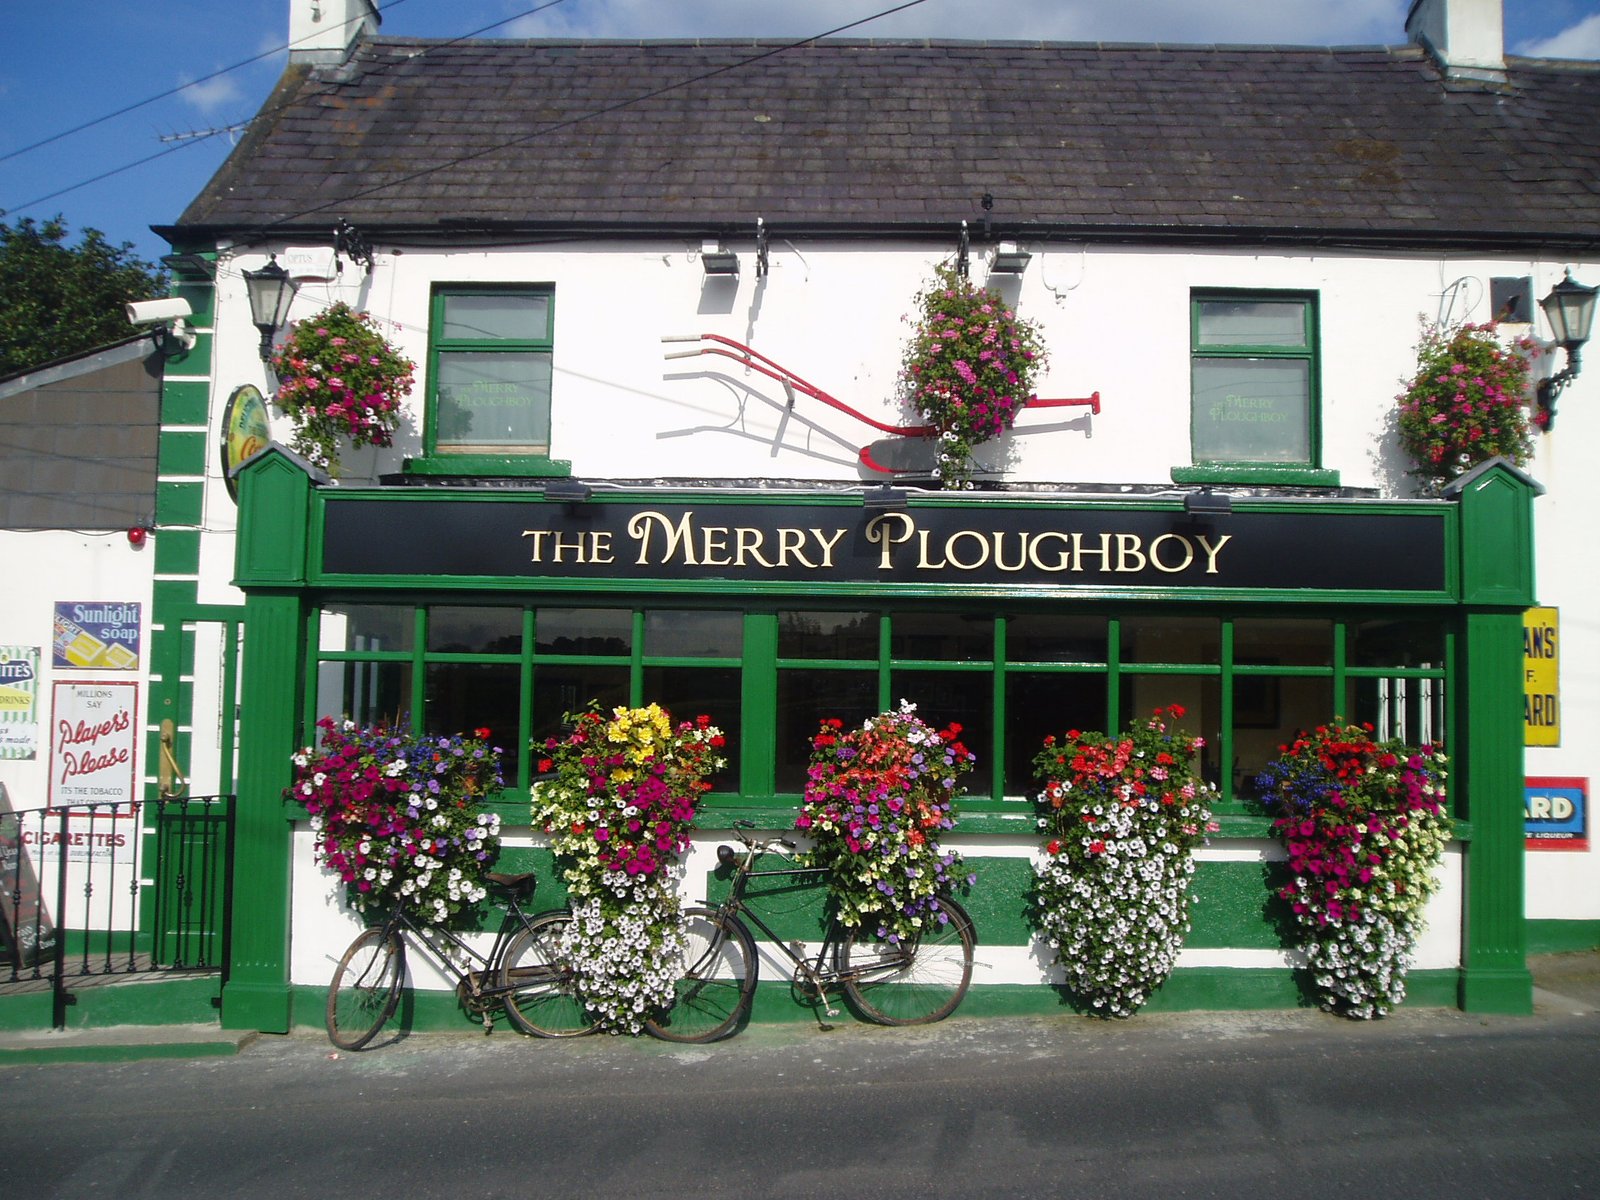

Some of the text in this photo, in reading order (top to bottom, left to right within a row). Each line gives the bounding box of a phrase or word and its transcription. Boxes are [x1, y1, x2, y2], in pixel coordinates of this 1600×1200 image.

[1226, 394, 1274, 408] MERRY
[522, 511, 1232, 574] THE MERRY PLOUGHBOY
[73, 604, 138, 628] Sunlight
[100, 627, 138, 644] soap
[0, 664, 31, 678] ITE'S
[77, 690, 113, 698] MILLIONS
[86, 701, 102, 709] SAY
[61, 747, 129, 785] Please
[74, 787, 88, 795] THE
[90, 787, 123, 796] TOBACCO
